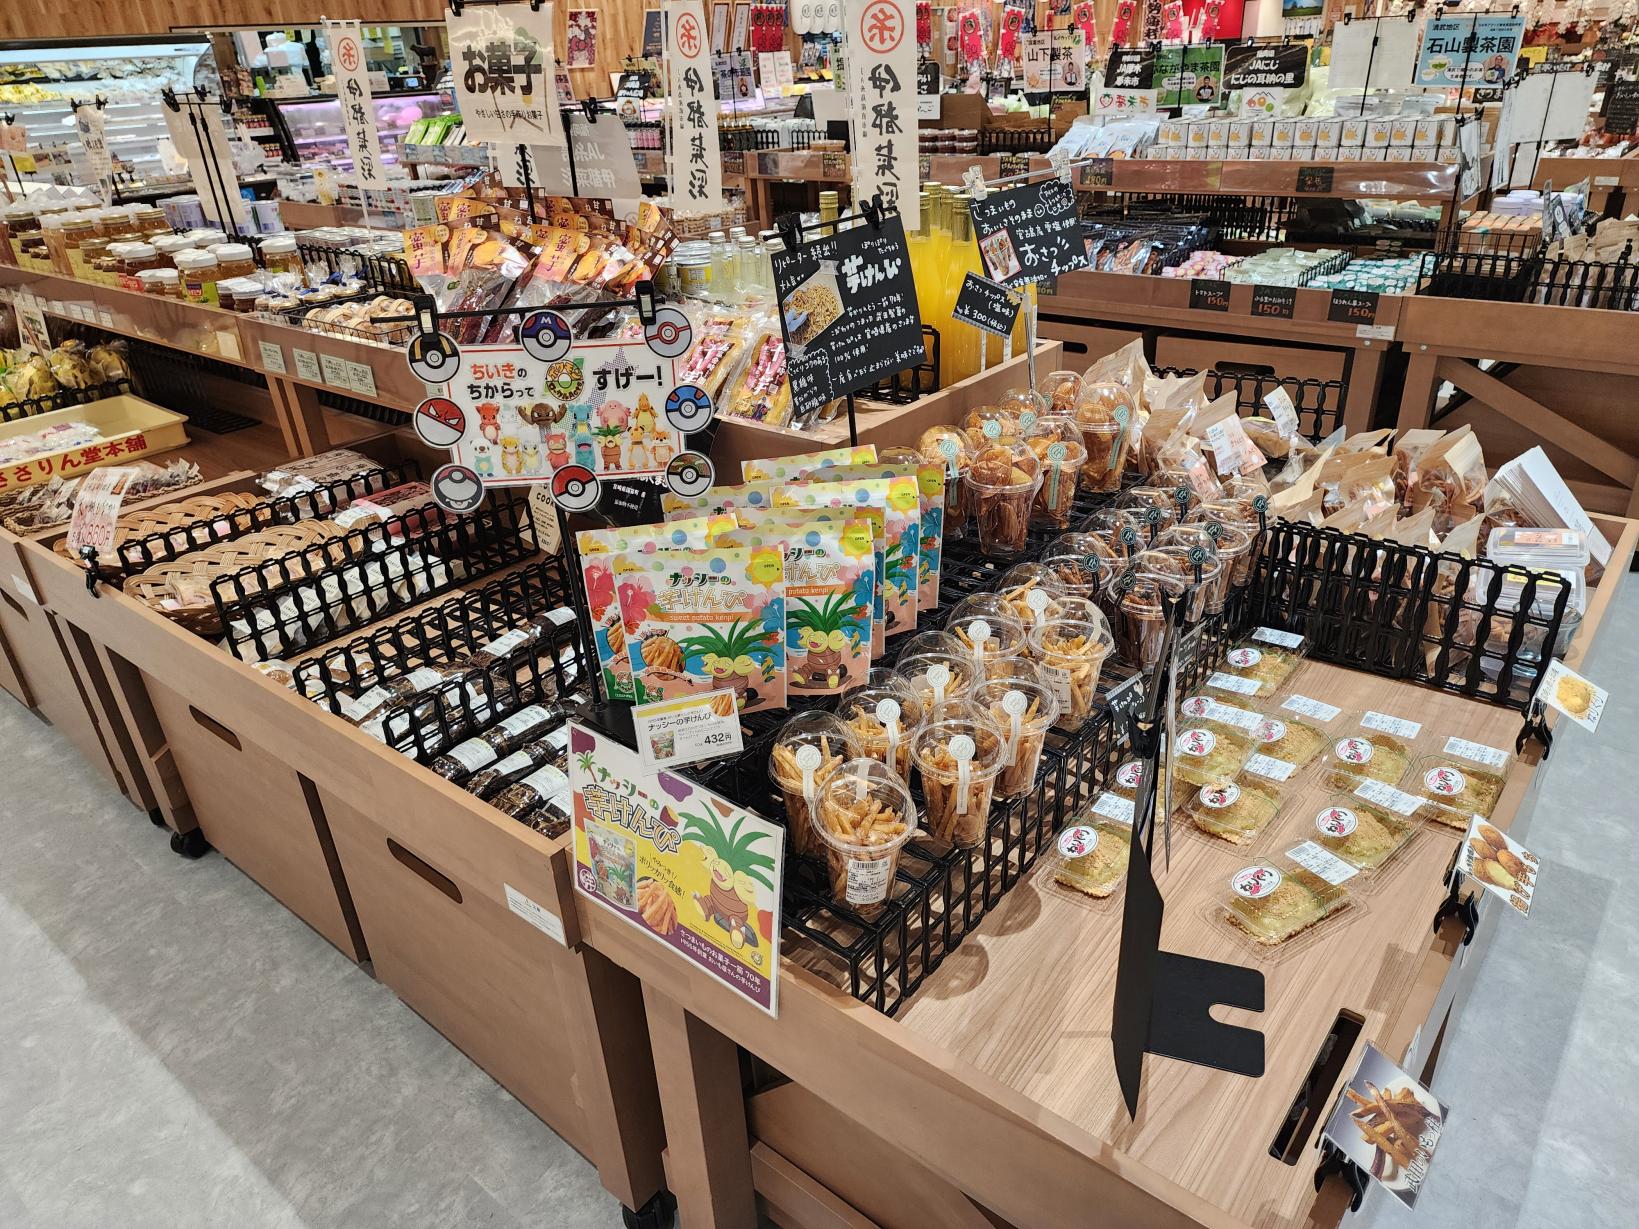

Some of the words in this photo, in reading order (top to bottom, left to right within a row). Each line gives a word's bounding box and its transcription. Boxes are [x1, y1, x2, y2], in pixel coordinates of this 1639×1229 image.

[1427, 36, 1516, 53] 石山製茶園
[1027, 47, 1073, 61] 山下製茶
[462, 42, 543, 95] お菓子
[1249, 60, 1279, 70] JAにじ
[842, 255, 902, 294] 芋けんぴ
[470, 363, 528, 381] ちいきの
[592, 365, 664, 390] すげー!
[467, 383, 535, 400] ちからって
[670, 572, 732, 587] ナッシーの
[657, 586, 748, 612] 芋けんぴ
[715, 614, 734, 622] kenpi
[647, 713, 712, 732] ナッシーの芋けんぴ
[704, 732, 732, 745] 432円
[597, 766, 660, 811] ナッシーの
[582, 784, 681, 853] 芋けんぴ
